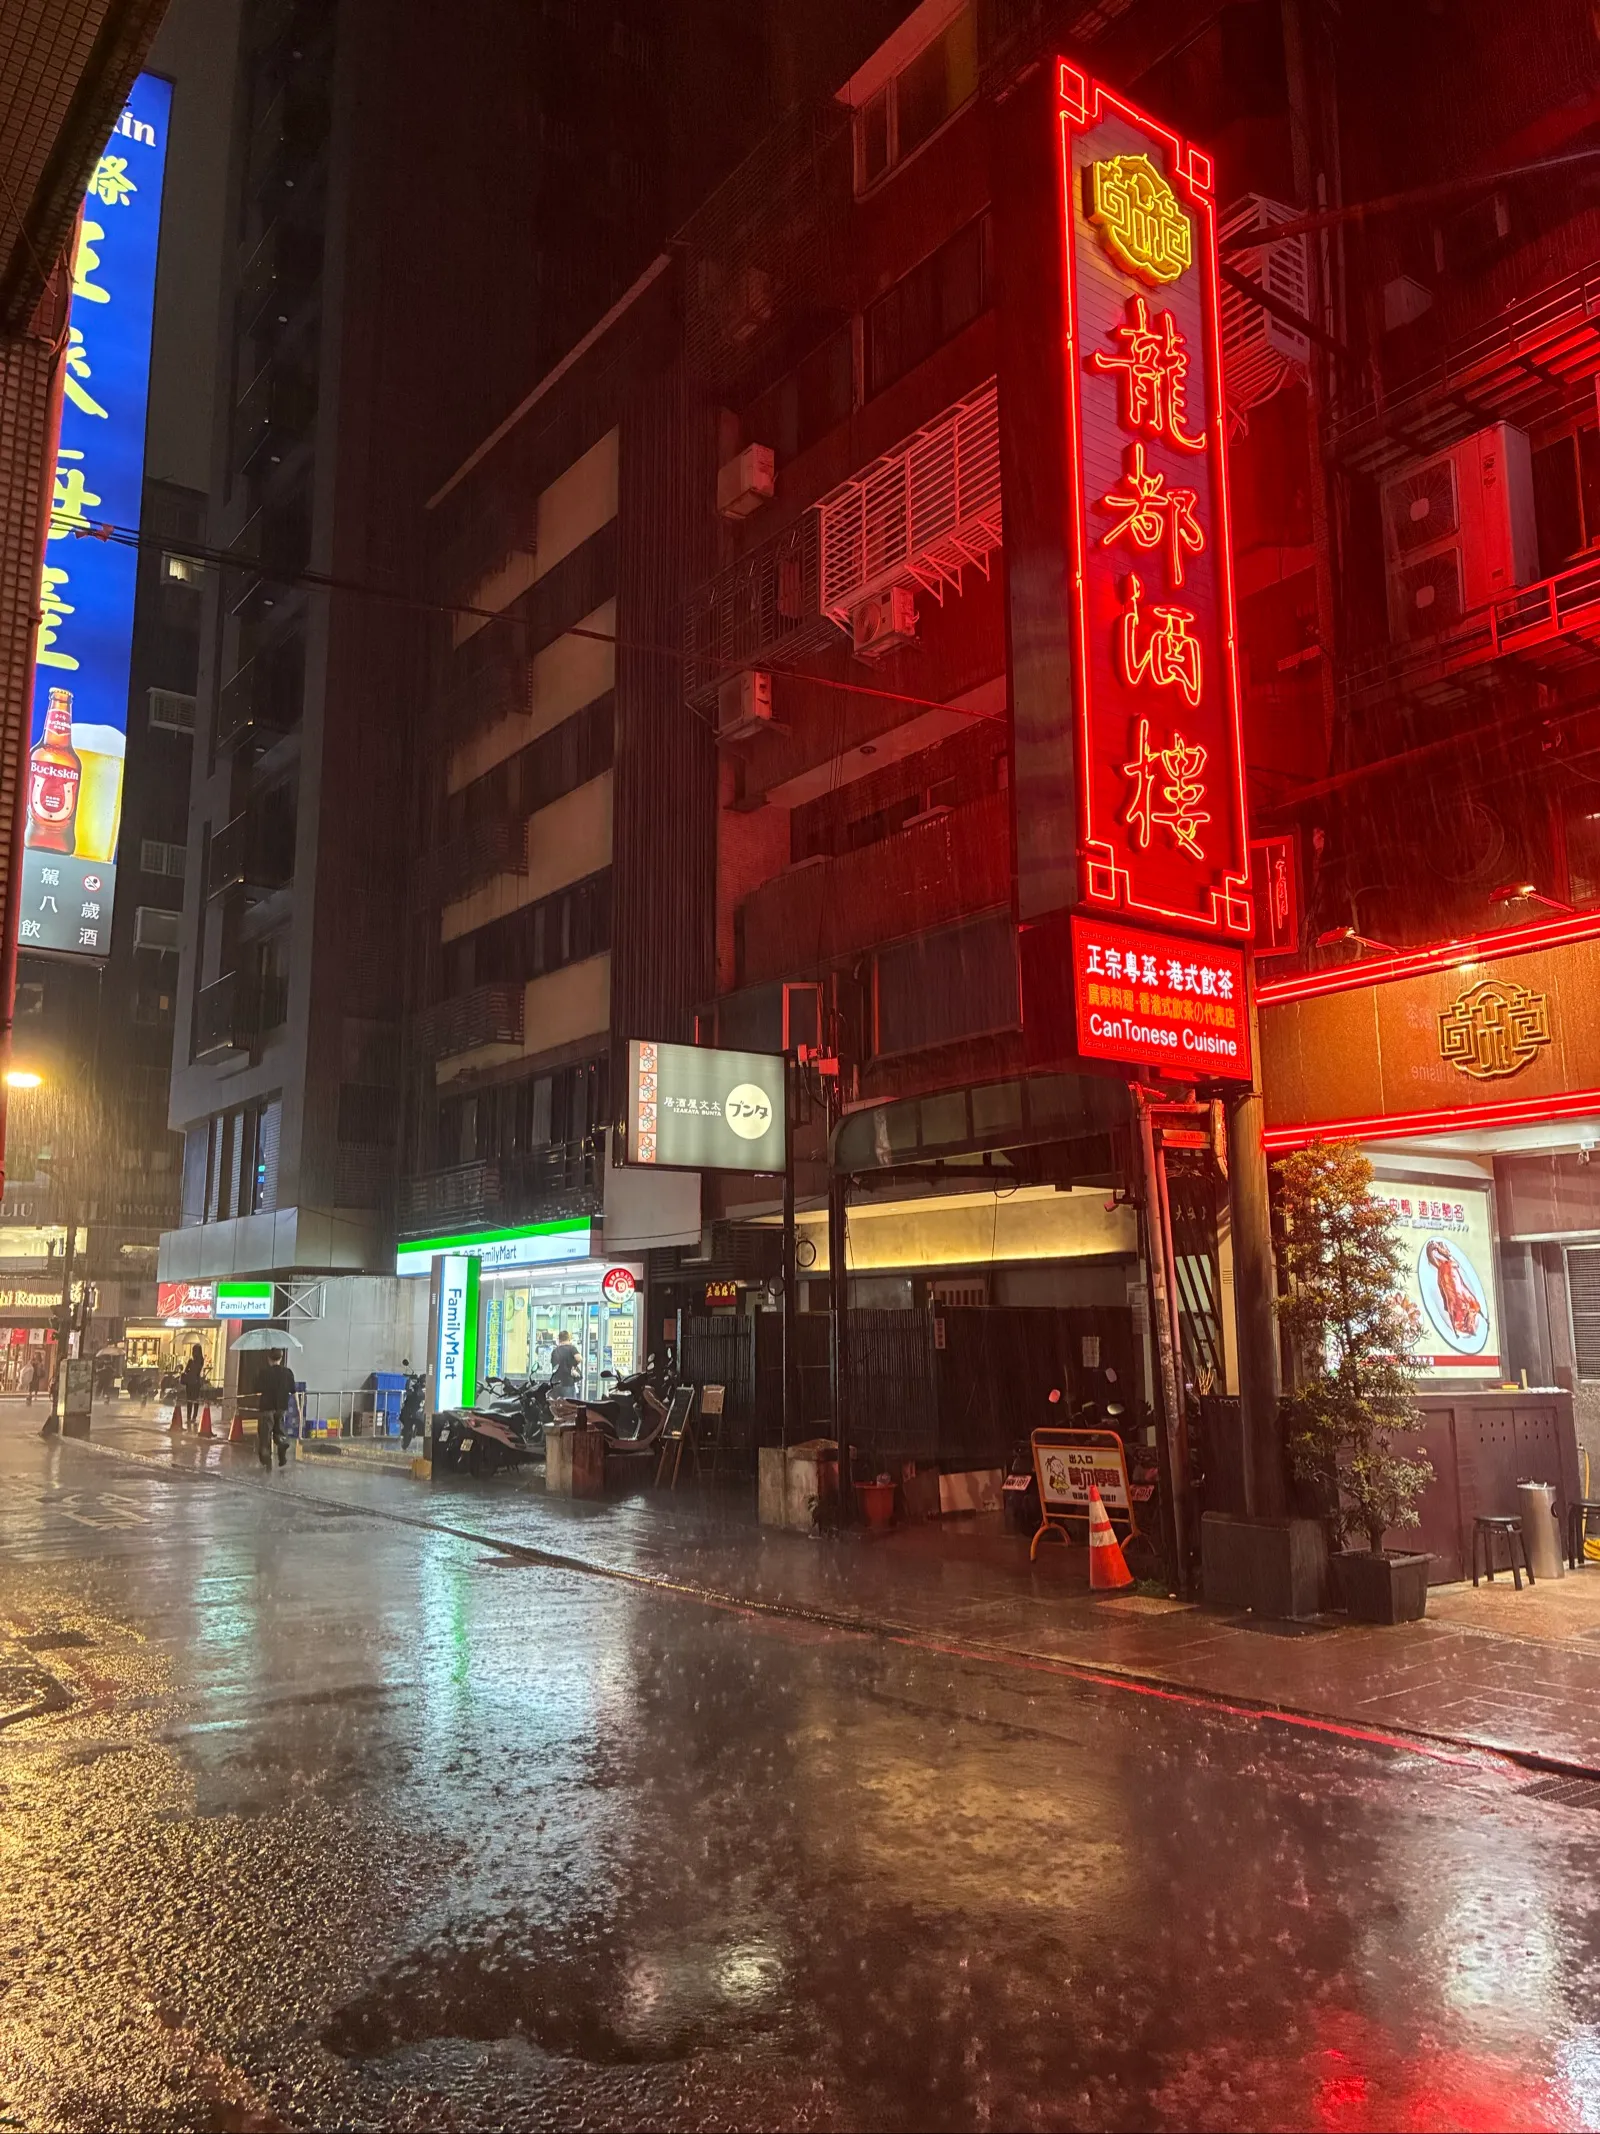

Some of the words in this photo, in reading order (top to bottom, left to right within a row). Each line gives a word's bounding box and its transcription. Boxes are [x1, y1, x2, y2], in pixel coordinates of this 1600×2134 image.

[1095, 297, 1210, 861] 龍都酒樓
[31, 761, 79, 781] Buckskin
[41, 867, 60, 886] 駕
[1089, 1013, 1178, 1048] CanTonese
[1182, 1028, 1237, 1056] Cuisine
[663, 1096, 722, 1111] 居酒屋文太
[673, 1107, 700, 1115] IZAKAYA
[701, 1108, 722, 1117] BUNTA
[729, 1100, 769, 1119] ブンタ
[1418, 1200, 1465, 1221] 遠近馳名
[477, 1245, 517, 1263] FamilyMart
[220, 1301, 267, 1311] FamilyMart
[444, 1288, 462, 1380] FamilyMart
[1068, 1454, 1094, 1465] 出入口
[1067, 1466, 1122, 1490] 請勿停車
